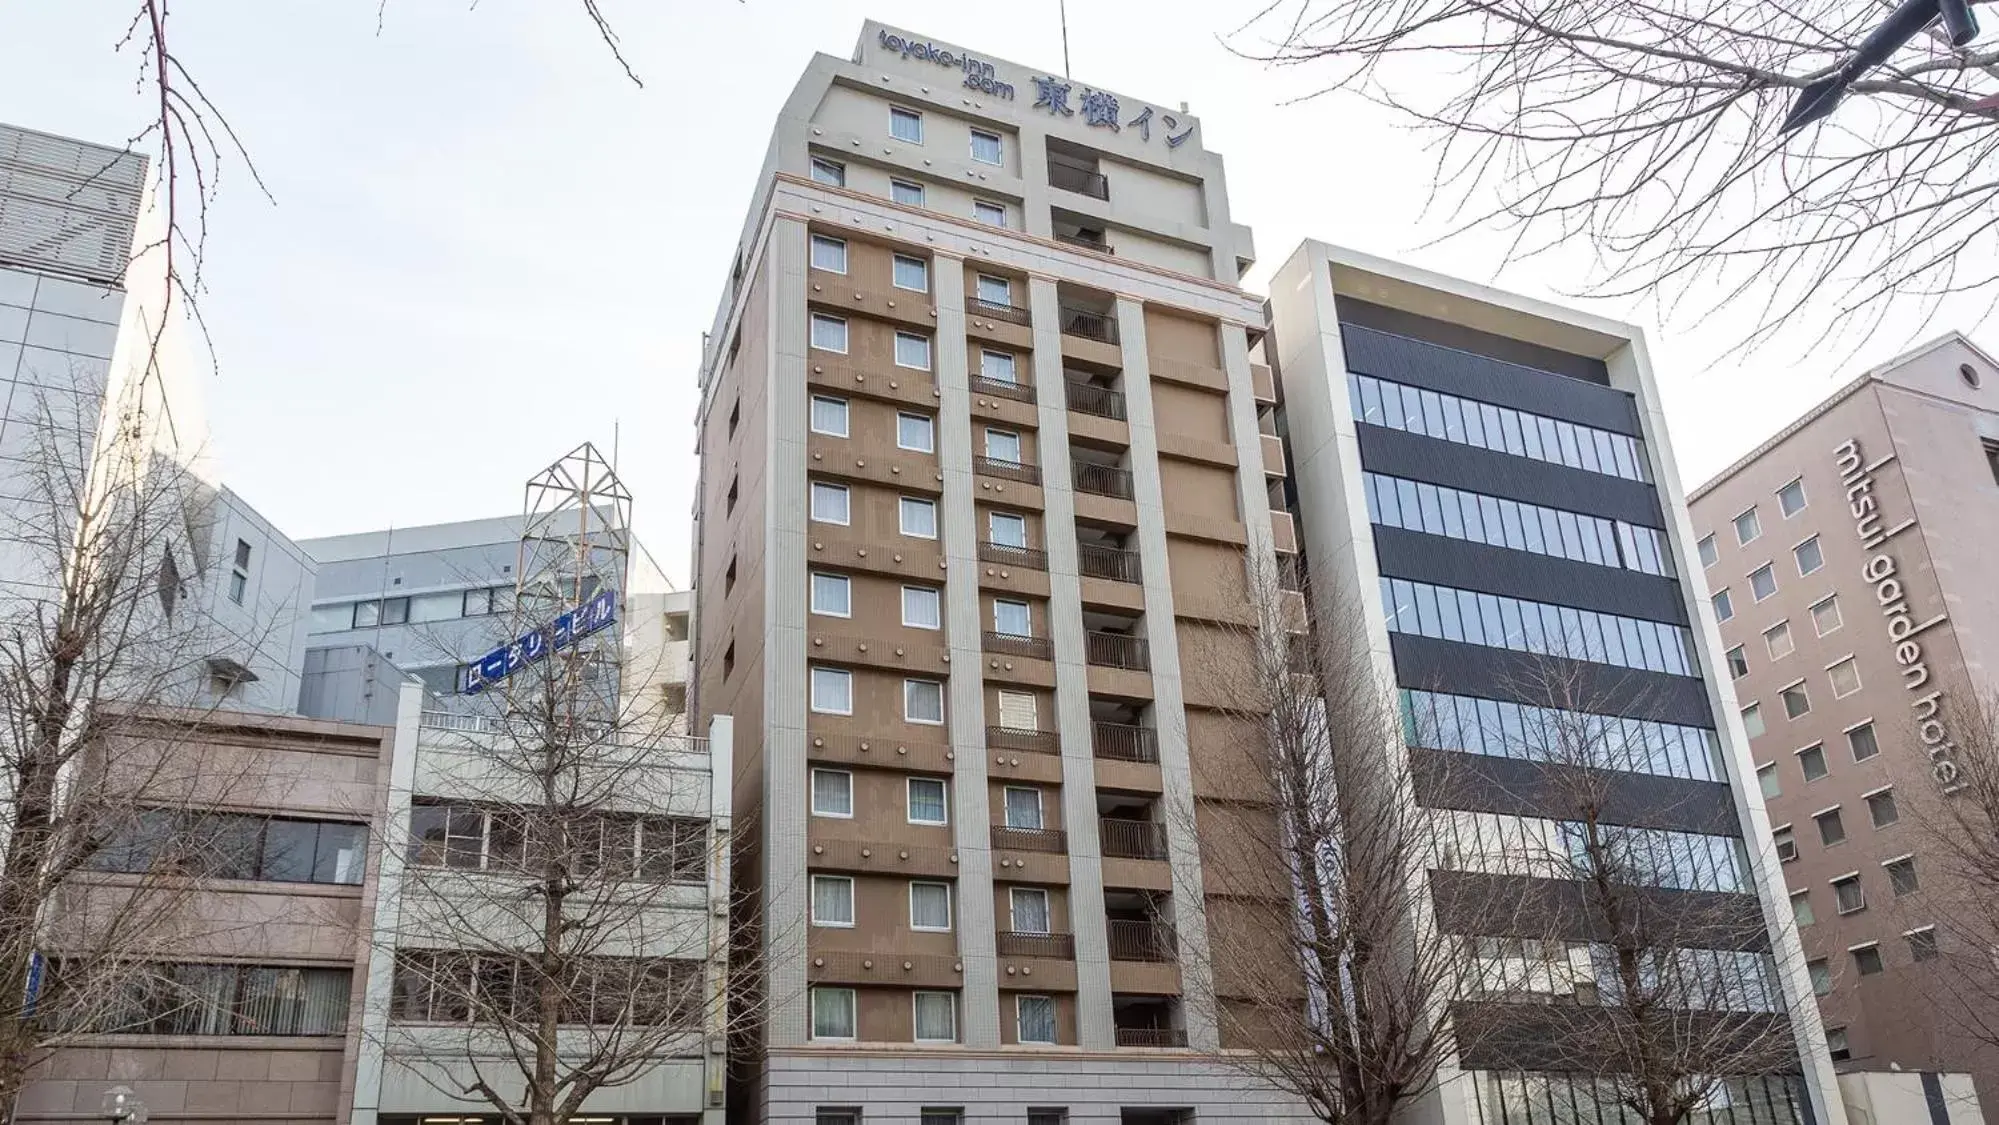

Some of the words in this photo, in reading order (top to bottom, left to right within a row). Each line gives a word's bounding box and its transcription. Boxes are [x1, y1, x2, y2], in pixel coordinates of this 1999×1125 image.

[878, 29, 995, 77] toyoko-inn
[963, 73, 1014, 101] .com
[1031, 76, 1194, 149] 東横イン
[1833, 438, 1917, 550] mitsui
[1862, 554, 1948, 690] garden
[1911, 690, 1970, 794] hotel
